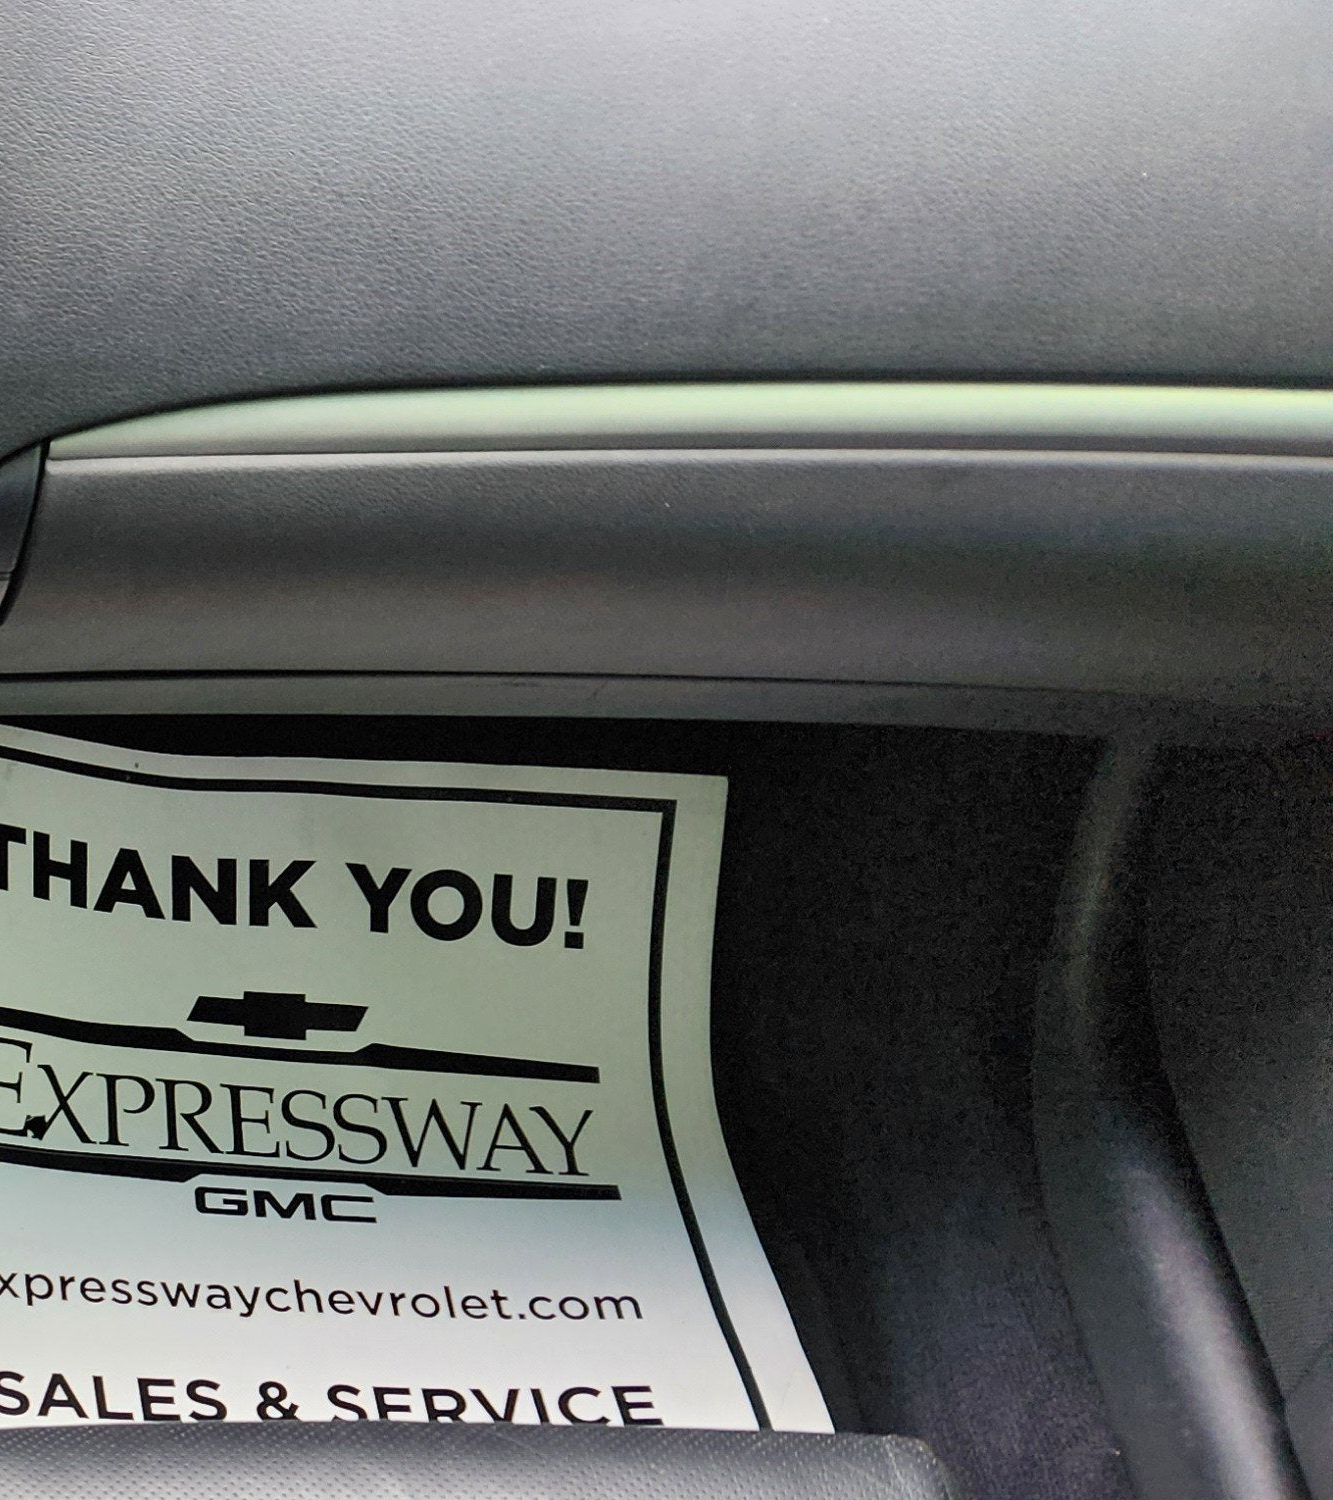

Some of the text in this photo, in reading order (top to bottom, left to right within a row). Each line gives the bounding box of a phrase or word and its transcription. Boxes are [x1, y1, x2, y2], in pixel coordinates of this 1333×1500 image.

[345, 861, 590, 951] YOU!
[194, 1185, 378, 1224] GMC
[255, 1381, 301, 1420] &
[324, 1384, 667, 1427] SERVICE
